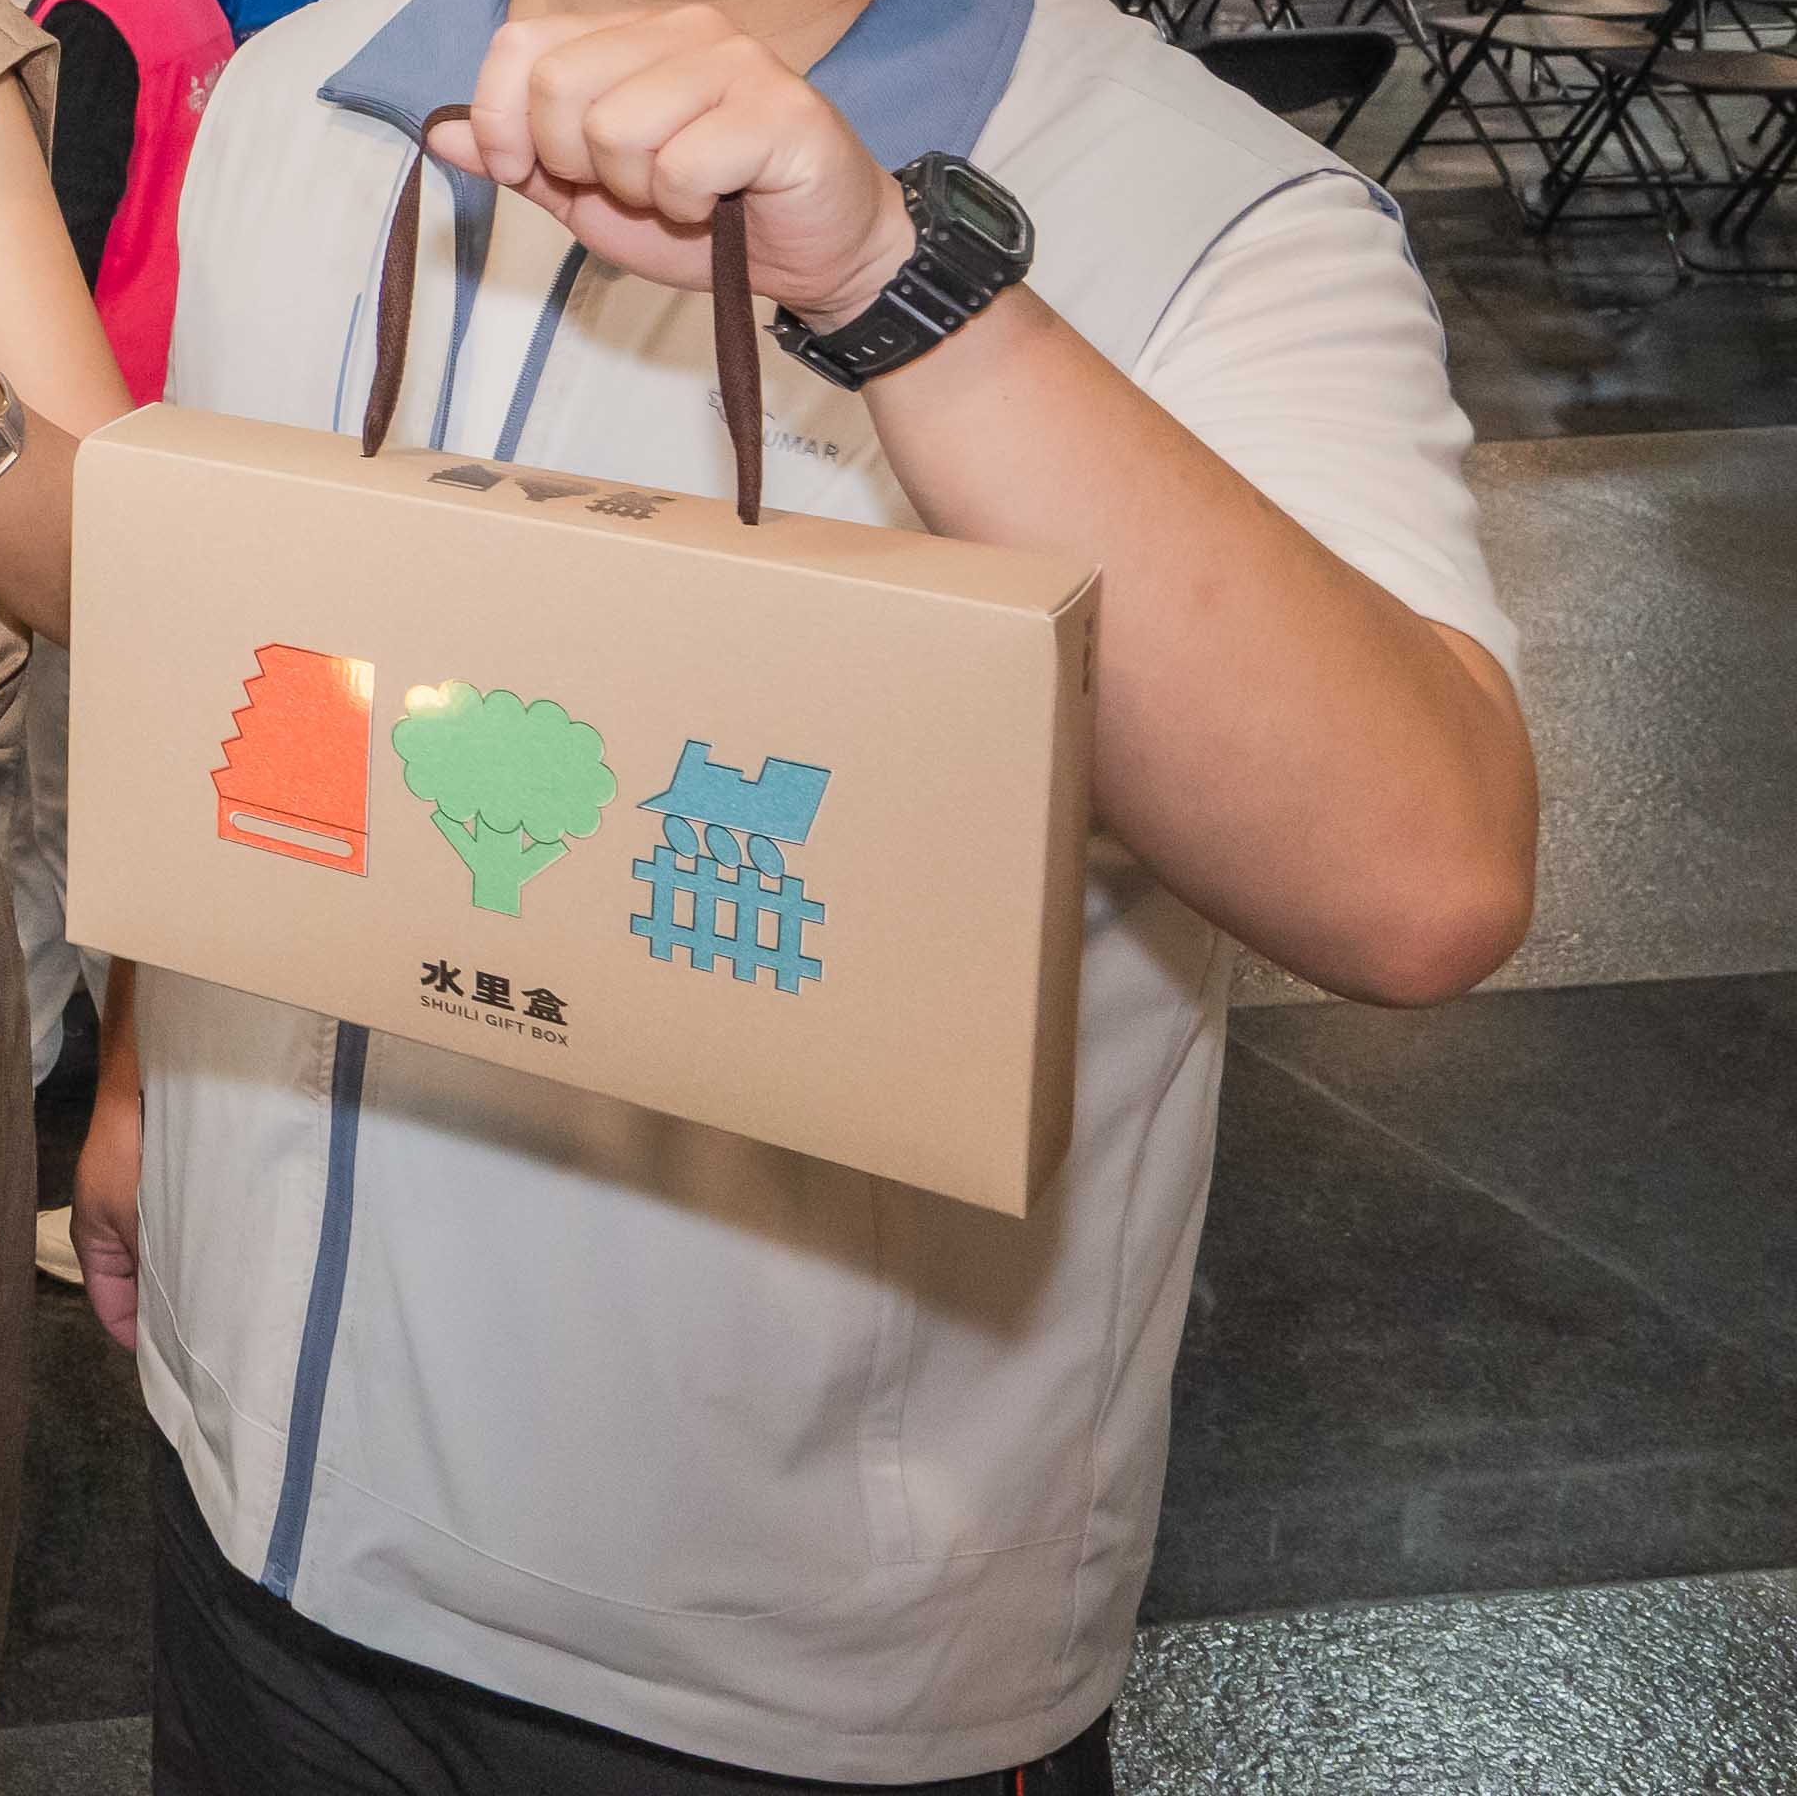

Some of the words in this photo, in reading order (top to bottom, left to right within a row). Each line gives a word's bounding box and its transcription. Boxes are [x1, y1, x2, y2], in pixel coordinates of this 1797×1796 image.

[419, 995, 479, 1022] SHUILI
[485, 1014, 526, 1035] GIFT
[531, 1026, 570, 1048] BOX
[420, 959, 569, 1026] 水里盒
